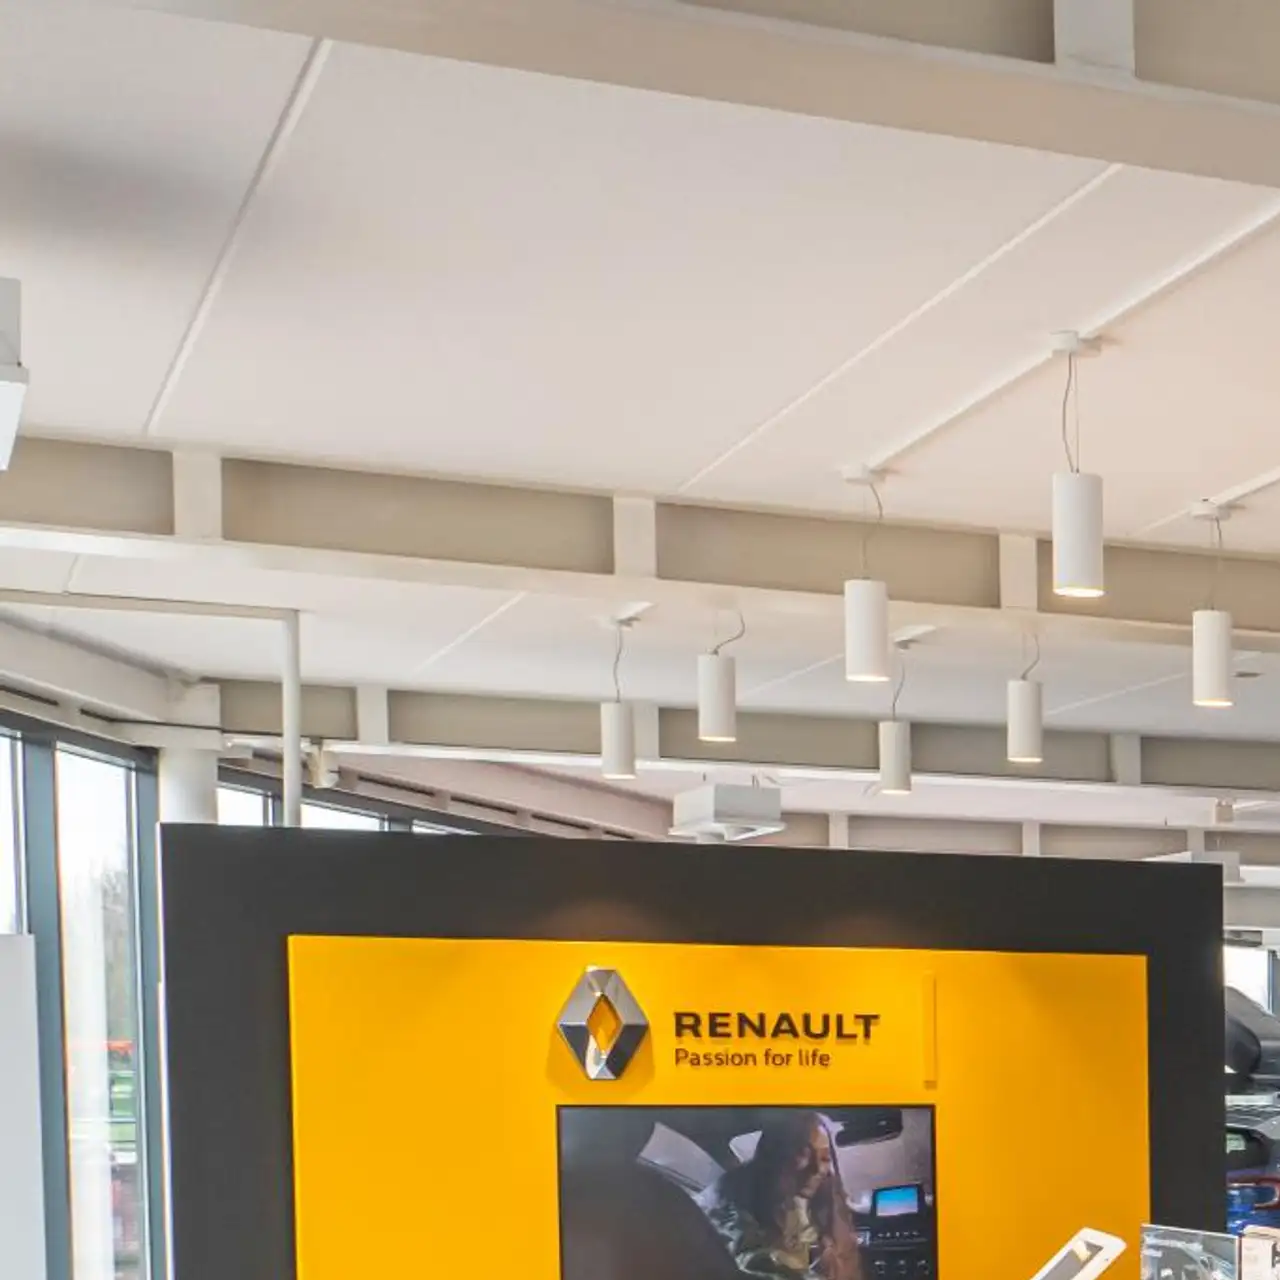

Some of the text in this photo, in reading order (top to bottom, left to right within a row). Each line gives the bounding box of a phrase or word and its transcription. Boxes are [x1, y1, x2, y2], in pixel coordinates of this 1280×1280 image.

[674, 1011, 880, 1040] RENAULT
[675, 1048, 830, 1066] Passion for life
